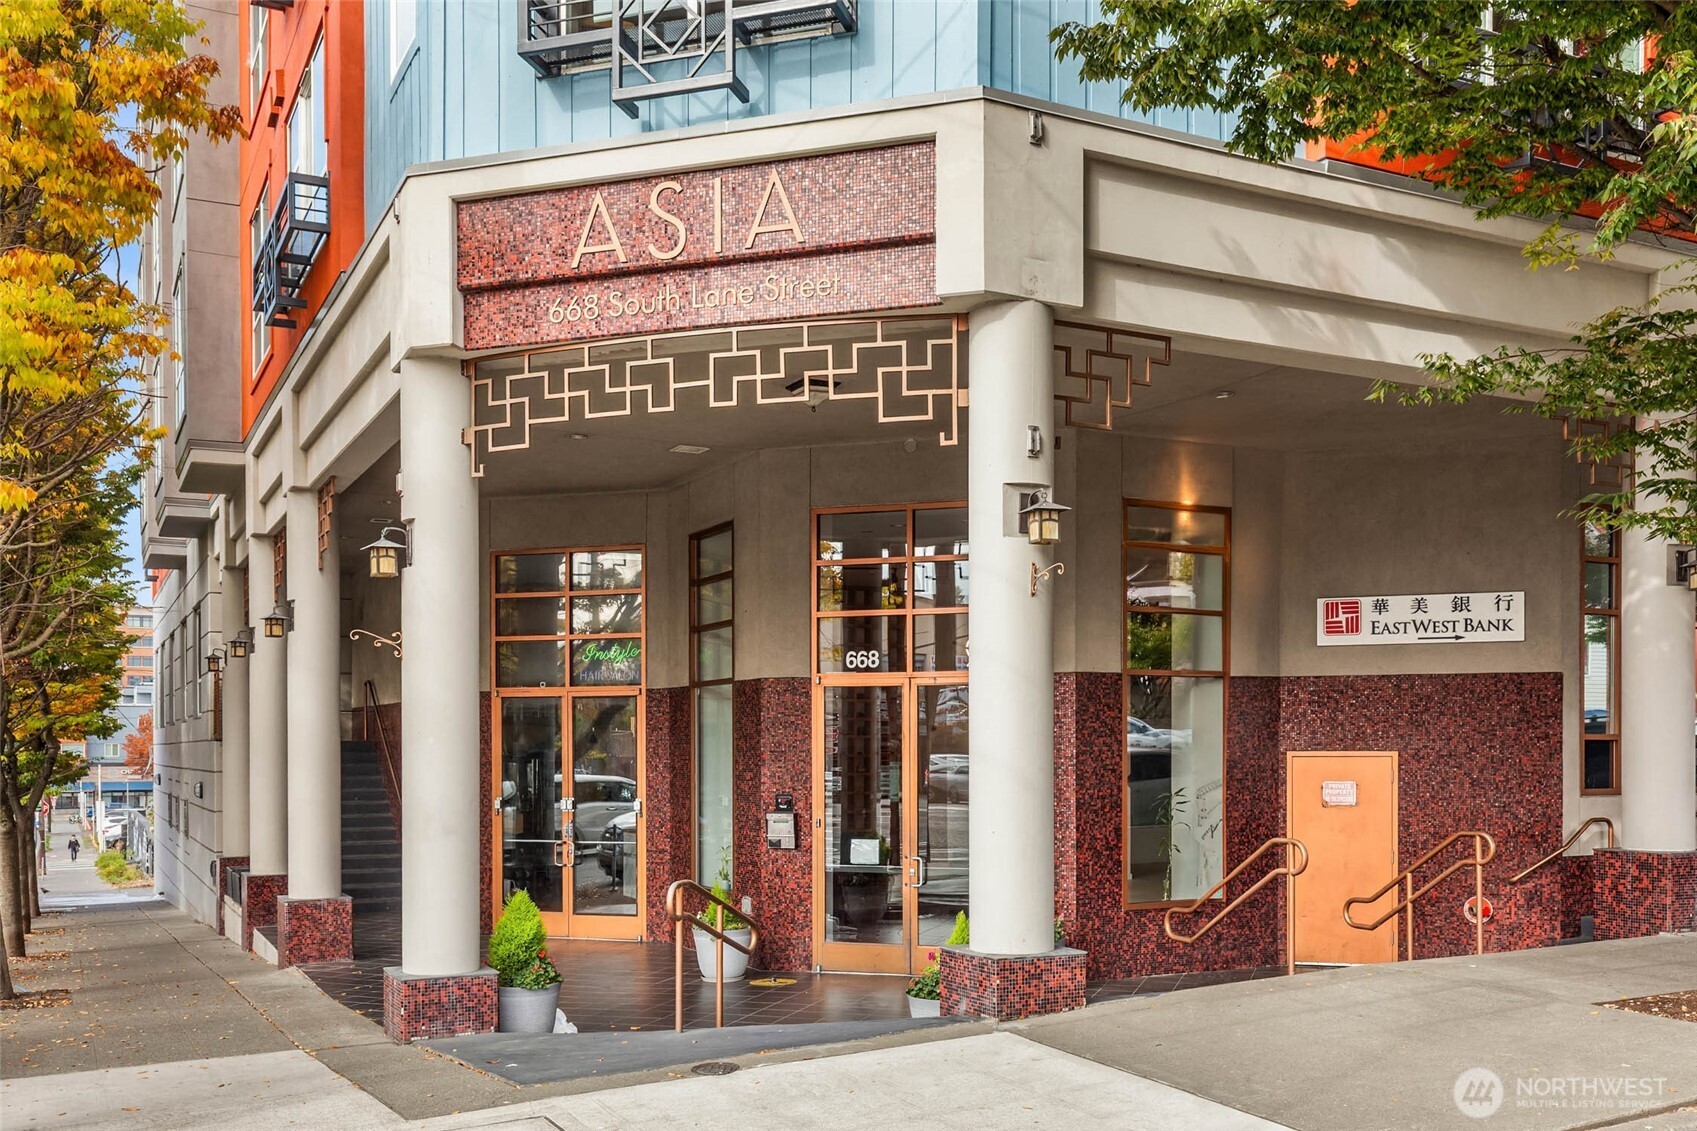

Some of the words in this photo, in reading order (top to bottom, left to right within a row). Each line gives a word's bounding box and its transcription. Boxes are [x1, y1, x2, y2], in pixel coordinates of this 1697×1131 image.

[571, 167, 805, 269] ASIA
[549, 294, 599, 323] 668
[609, 285, 681, 317] South
[692, 280, 754, 308] Lane
[765, 273, 841, 301] Street
[1371, 594, 1514, 616] 華美銀行
[1463, 617, 1515, 633] BANK
[582, 641, 641, 666] Instyle
[846, 650, 879, 668] 668
[580, 671, 603, 681] HAIR
[604, 670, 640, 680] SALON
